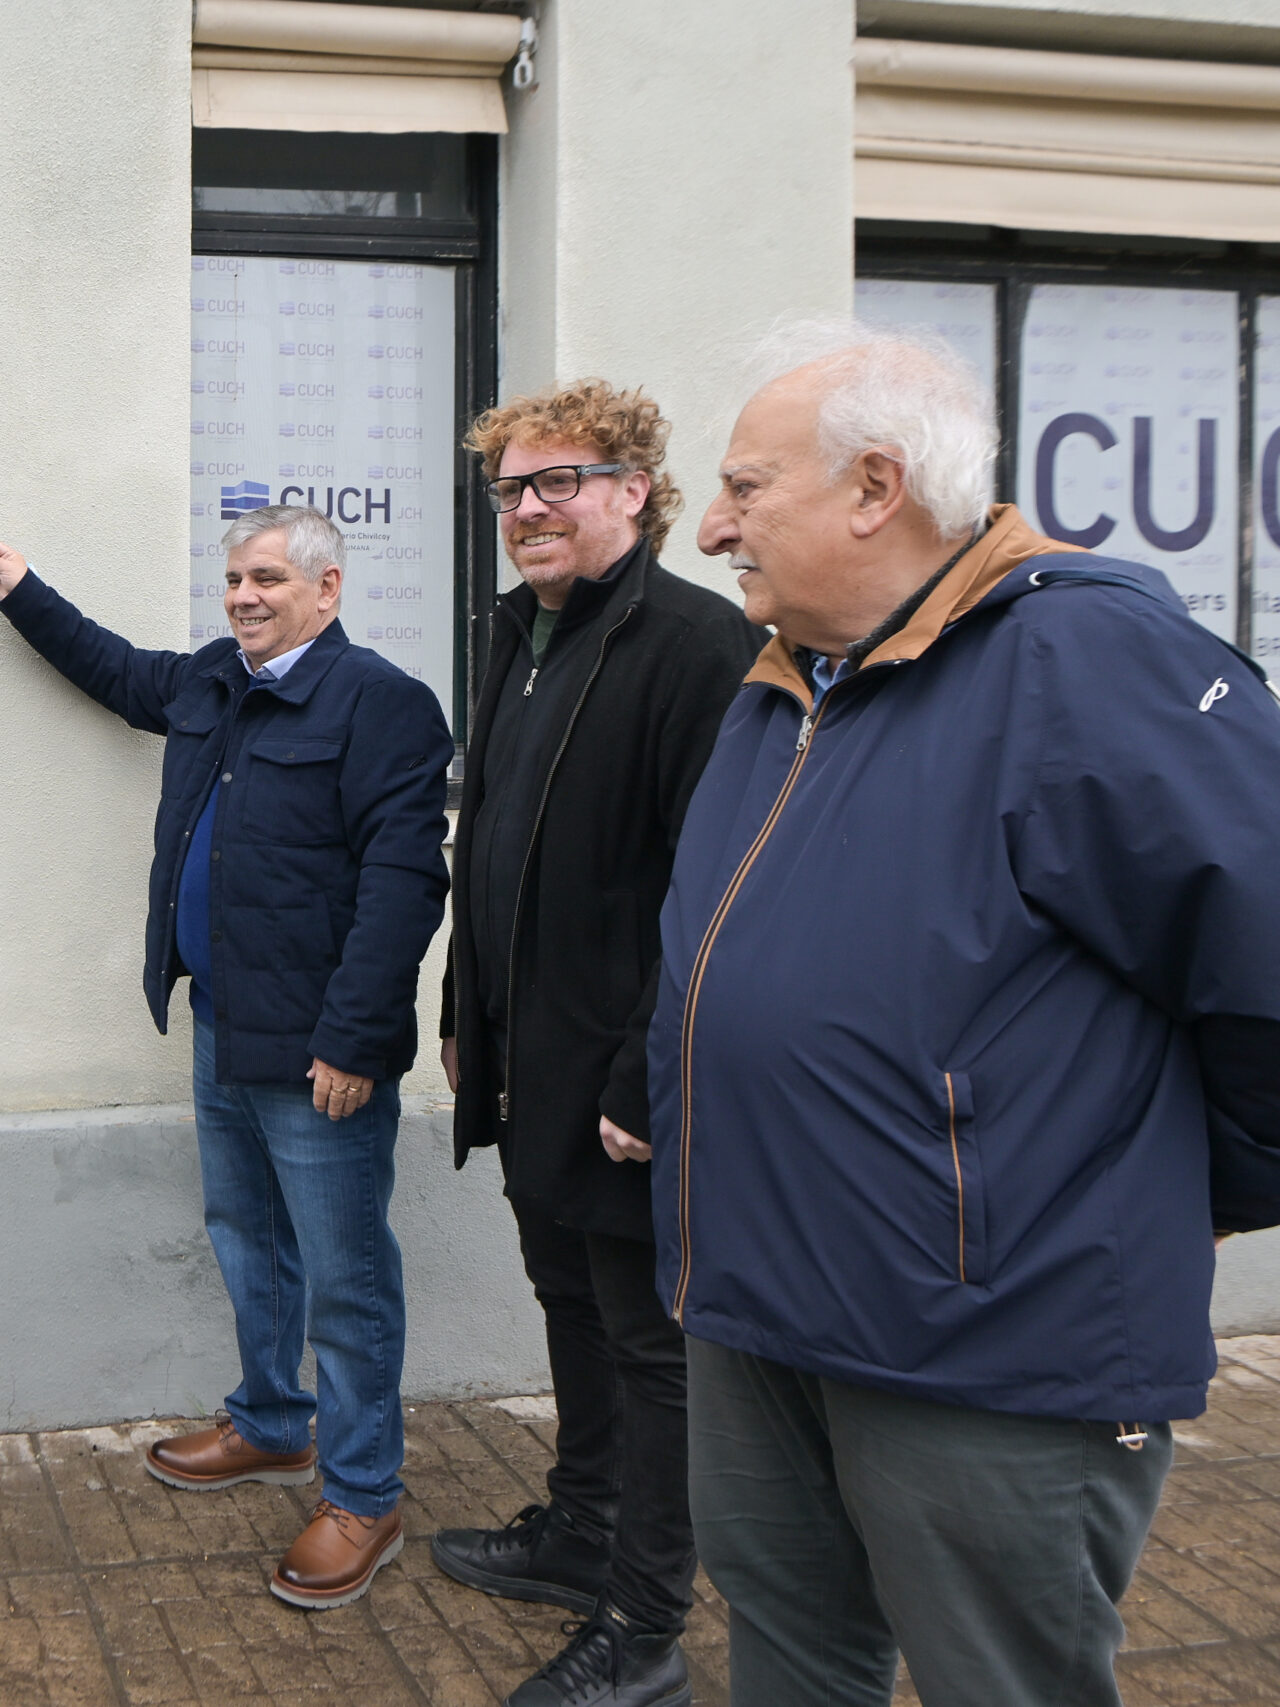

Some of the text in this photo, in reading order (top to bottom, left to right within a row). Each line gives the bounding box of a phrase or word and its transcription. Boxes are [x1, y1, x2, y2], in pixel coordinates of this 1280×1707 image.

[207, 258, 245, 273] CUCH
[297, 262, 336, 276] CUCH
[386, 264, 424, 279] CUCH
[207, 299, 245, 313] CUCH
[297, 303, 336, 316] CUCH
[386, 306, 424, 320] CUCH
[207, 340, 245, 354] CUCH
[297, 343, 336, 357] CUCH
[386, 346, 424, 360] CUCH
[207, 381, 245, 394] CUCH
[297, 384, 336, 398] CUCH
[386, 387, 424, 400] CUCH
[207, 422, 245, 435] CUCH
[297, 424, 336, 438] CUCH
[386, 427, 424, 440] CUCH
[207, 463, 245, 476] CUCH
[297, 465, 336, 478] CUCH
[386, 466, 424, 480] CUCH
[357, 532, 391, 541] Chivilcoy
[386, 546, 423, 560] CUCH
[386, 587, 423, 601] CUCH
[386, 627, 423, 641] CUCH
